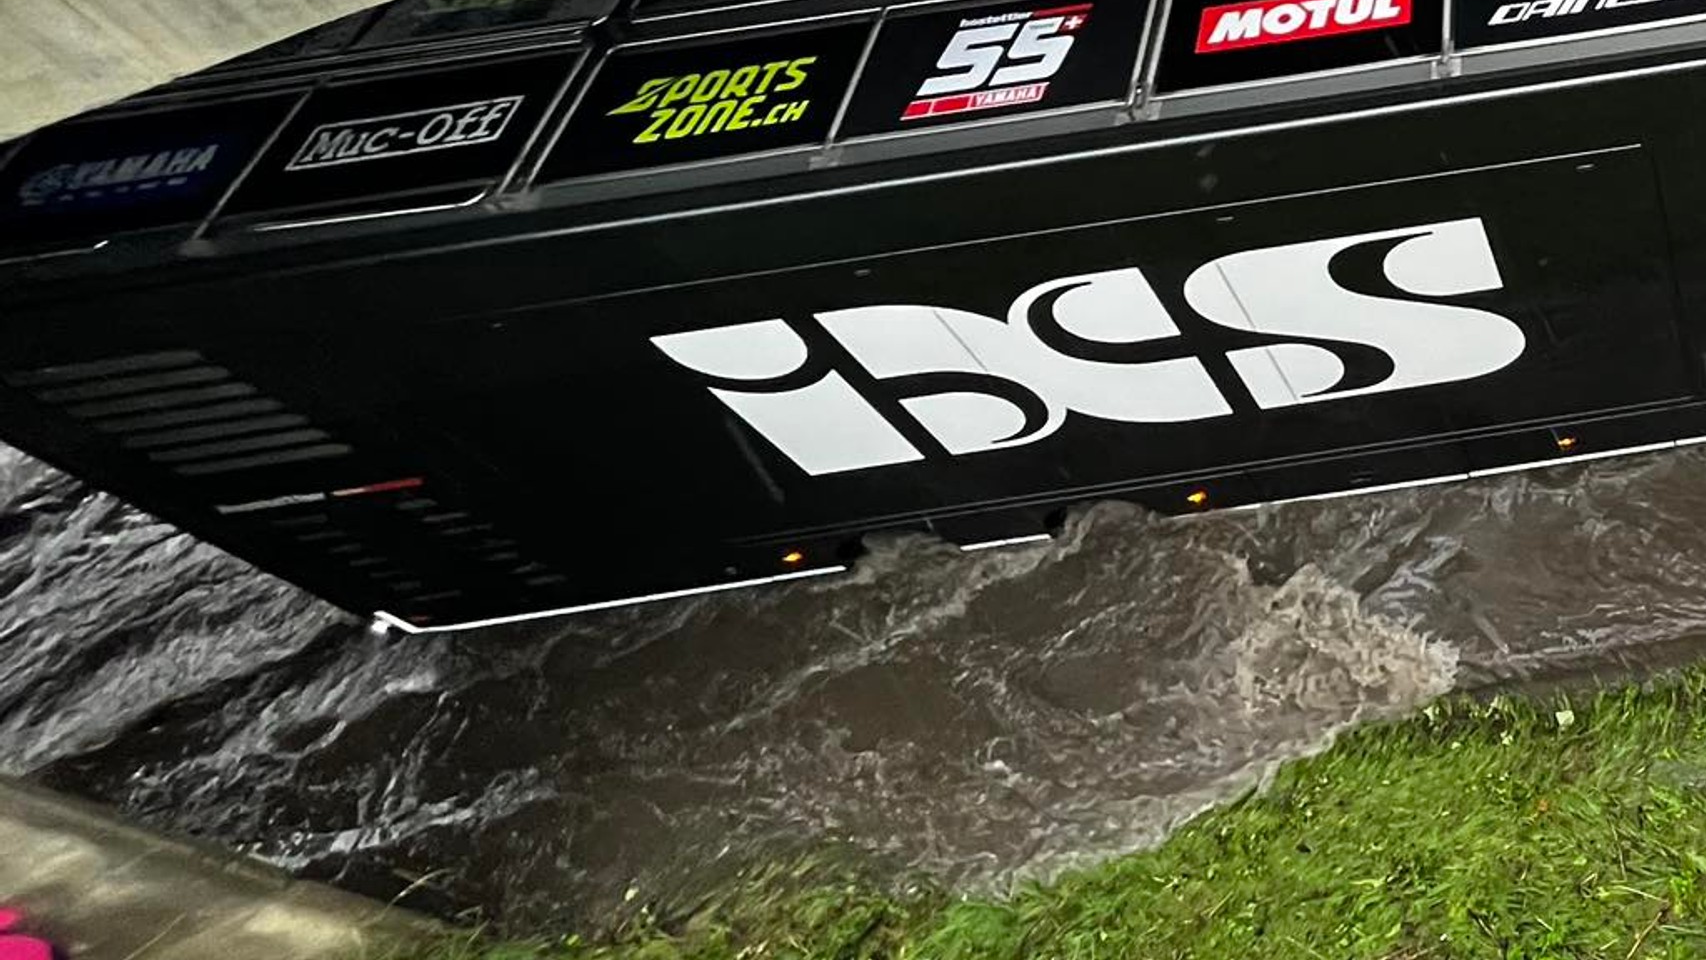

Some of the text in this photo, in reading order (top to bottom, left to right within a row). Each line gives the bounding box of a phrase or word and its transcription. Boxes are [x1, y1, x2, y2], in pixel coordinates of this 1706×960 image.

[605, 56, 818, 116] SPORTS
[916, 16, 1075, 96] 55
[974, 85, 1039, 108] YAMAHA
